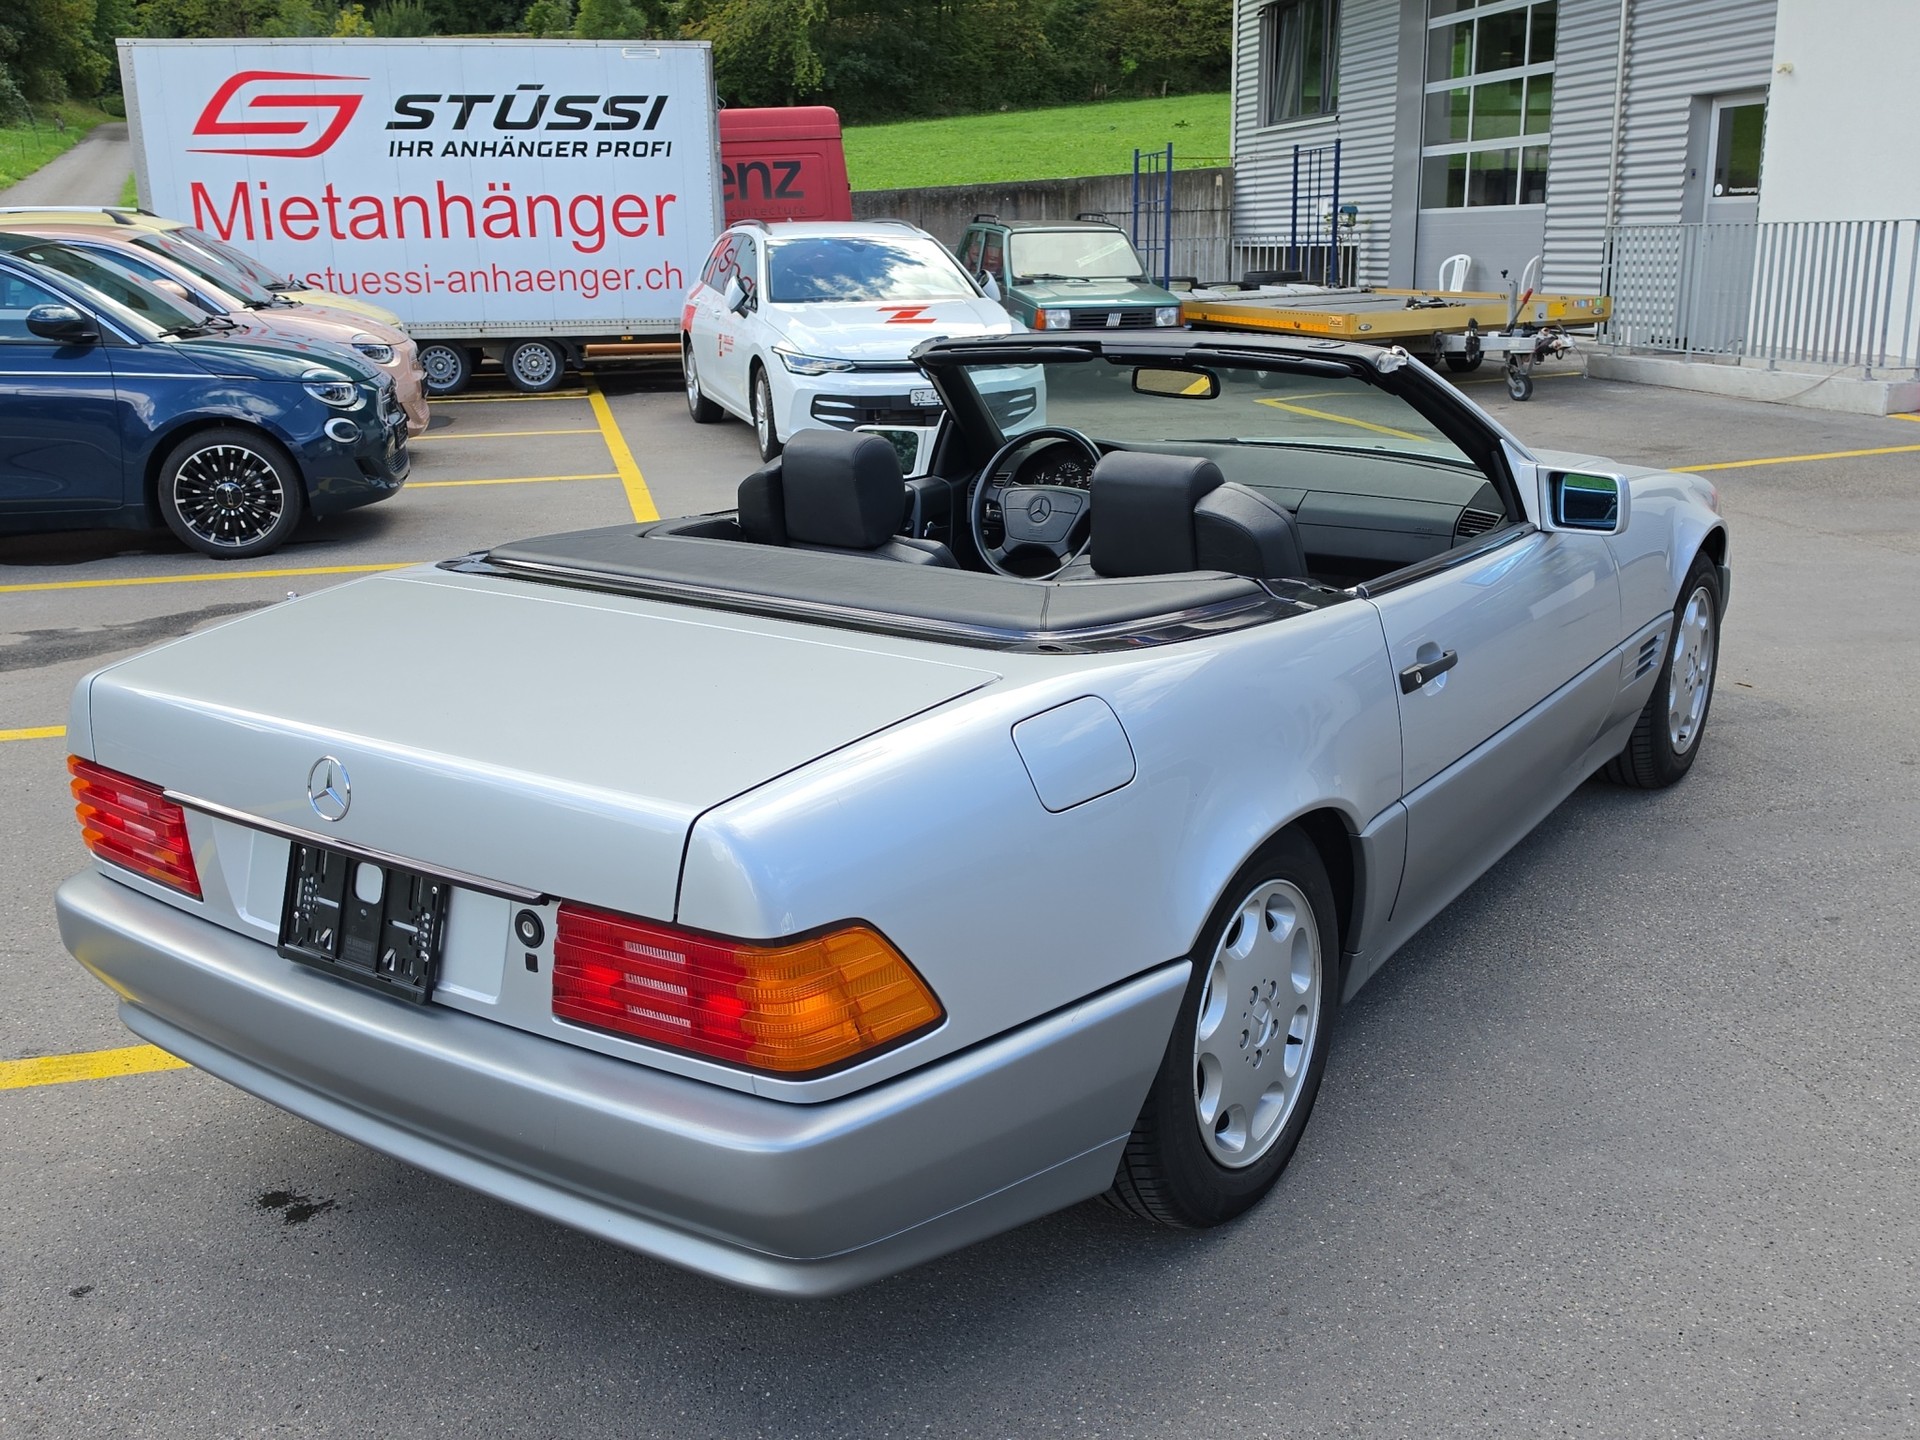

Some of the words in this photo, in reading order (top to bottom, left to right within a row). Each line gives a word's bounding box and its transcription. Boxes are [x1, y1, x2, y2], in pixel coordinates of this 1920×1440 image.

[389, 140, 434, 158] IHR
[440, 136, 588, 158] ANHÄNGER
[596, 141, 672, 158] PROFI
[190, 181, 677, 254] Mietanhänger
[289, 260, 684, 300] stuessi-anhaenger.ch
